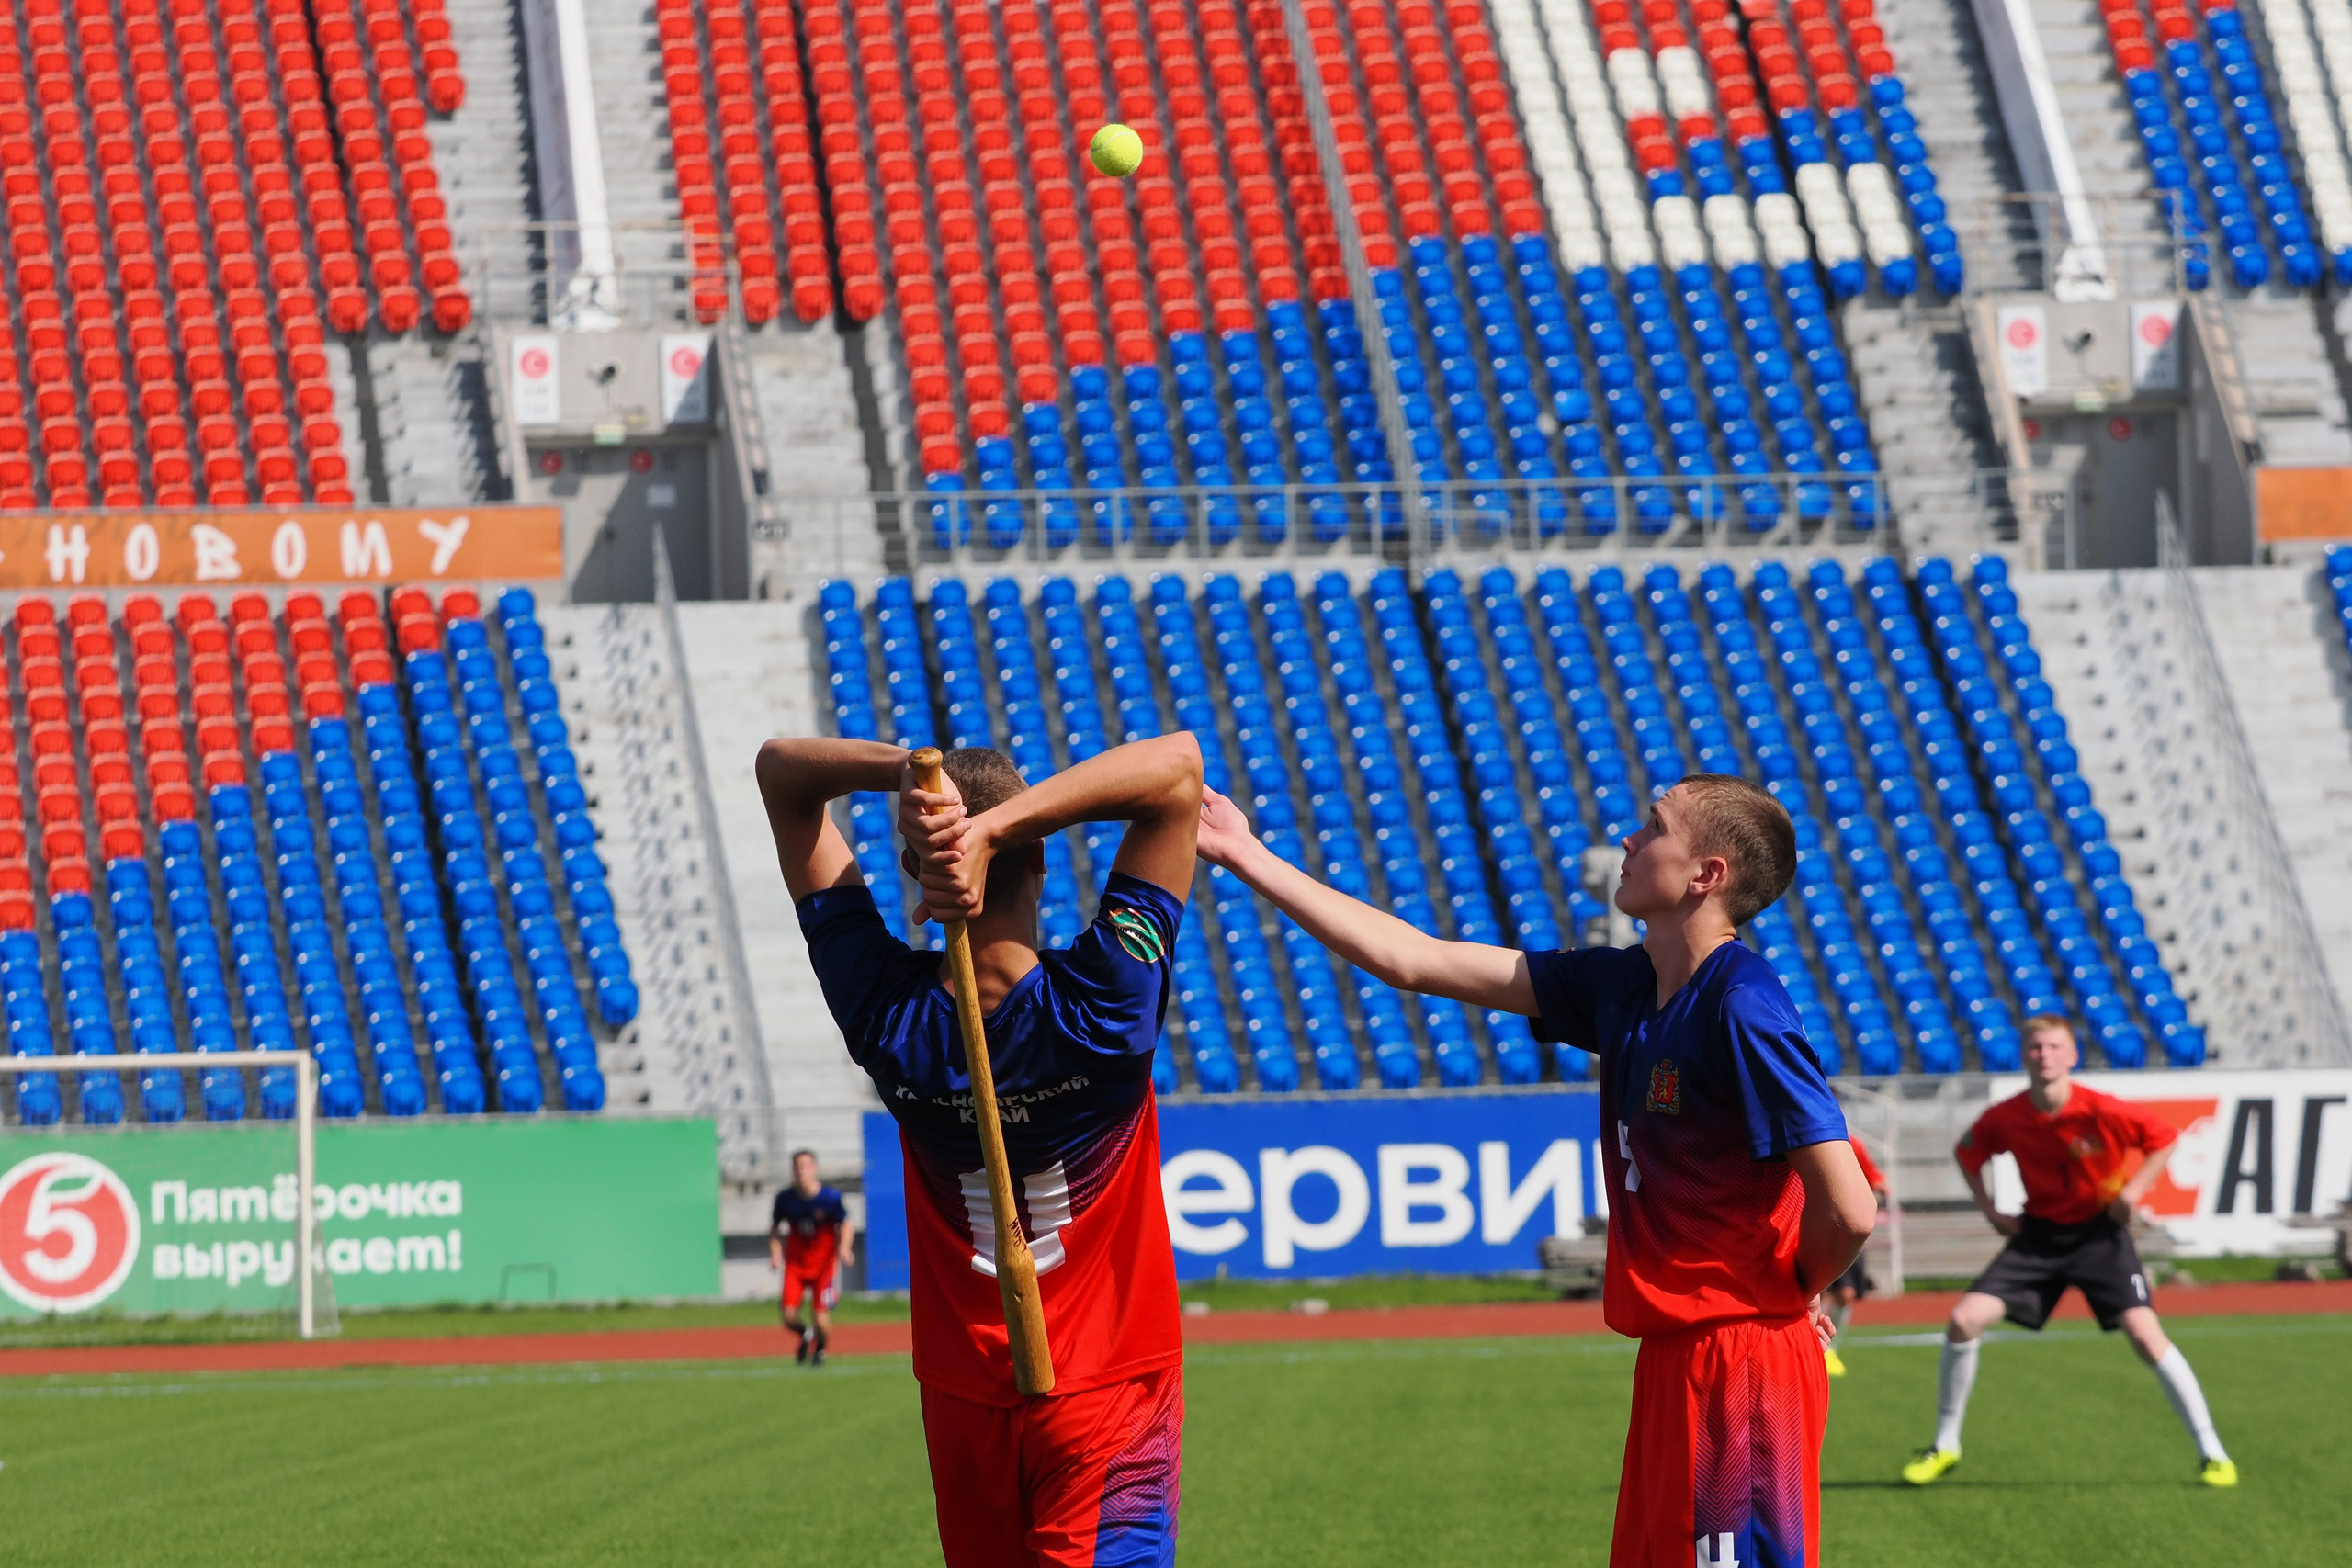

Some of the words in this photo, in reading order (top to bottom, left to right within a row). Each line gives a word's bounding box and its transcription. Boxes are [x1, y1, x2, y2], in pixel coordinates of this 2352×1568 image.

[0, 516, 469, 583] НОВОМУ
[959, 1105, 1030, 1124] КАЙ
[2215, 1097, 2352, 1213] АГ
[23, 1163, 109, 1283] 5
[151, 1173, 462, 1224] Пятёрочка
[1159, 1138, 1610, 1269] ерви
